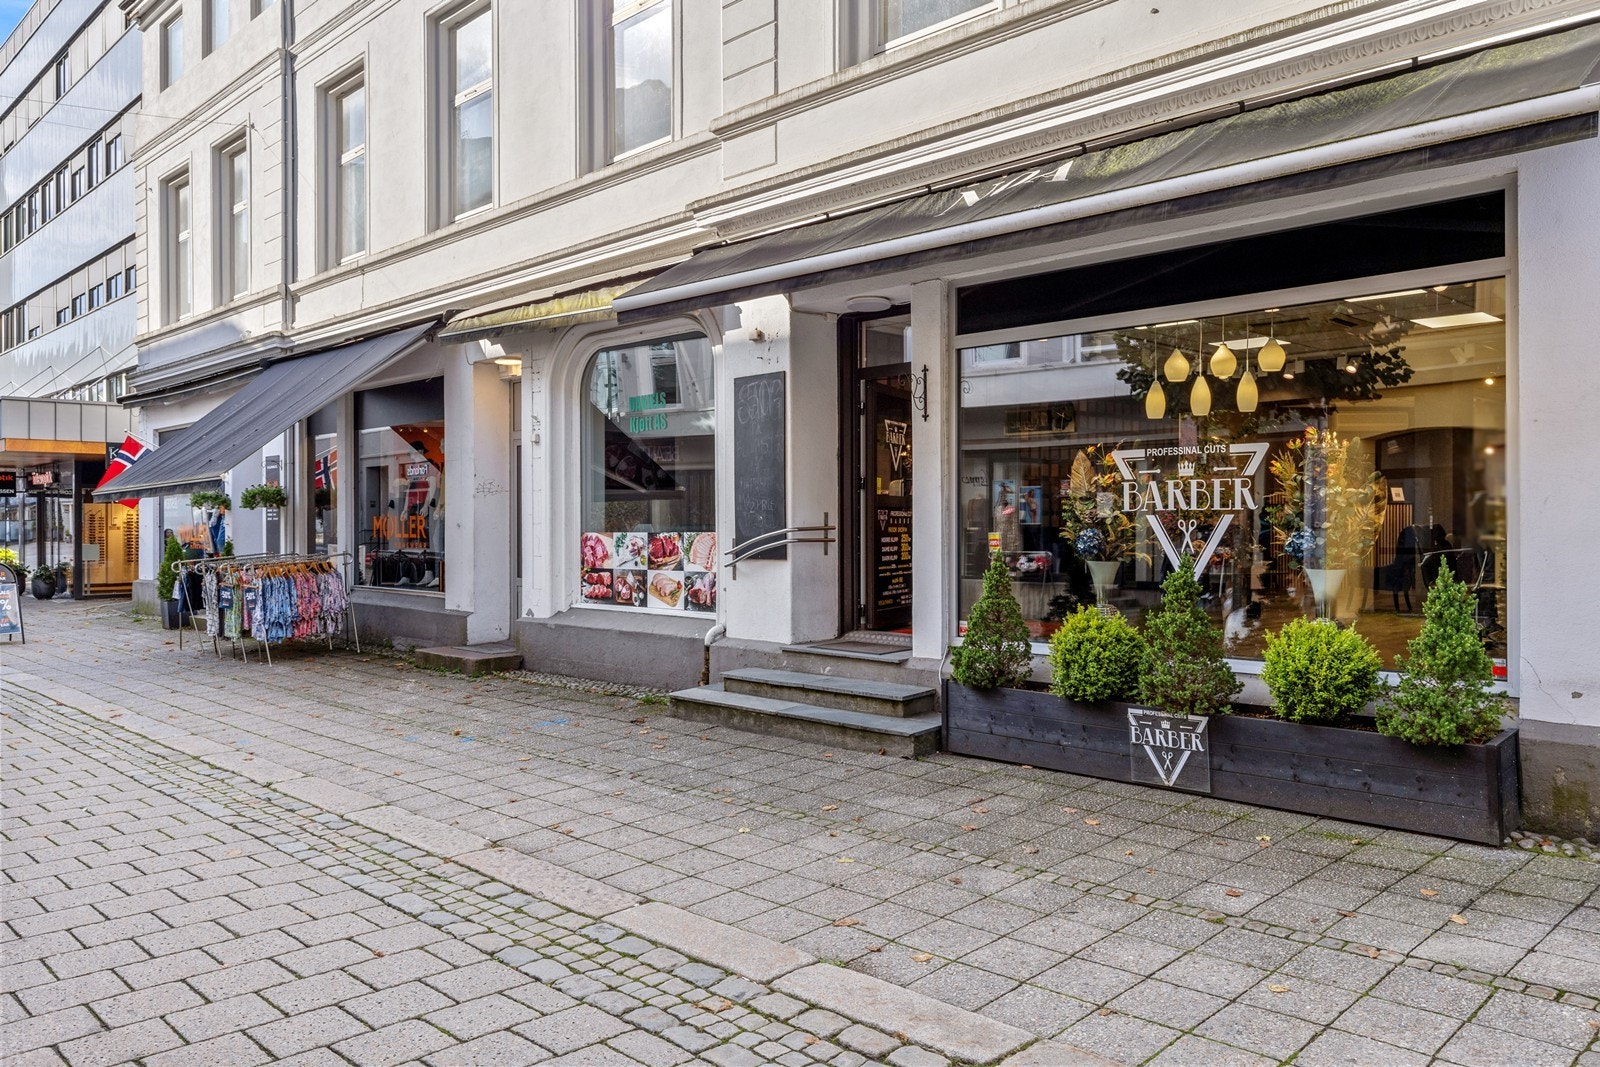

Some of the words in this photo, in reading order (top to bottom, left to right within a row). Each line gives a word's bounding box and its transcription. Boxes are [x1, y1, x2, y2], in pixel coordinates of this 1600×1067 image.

[654, 412, 668, 430] AS
[1146, 445, 1202, 457] PROFESSINAL
[1203, 444, 1227, 454] CUTS
[1121, 477, 1259, 512] BARBER
[373, 513, 427, 540] MØLLER
[1130, 725, 1205, 752] BARBER
